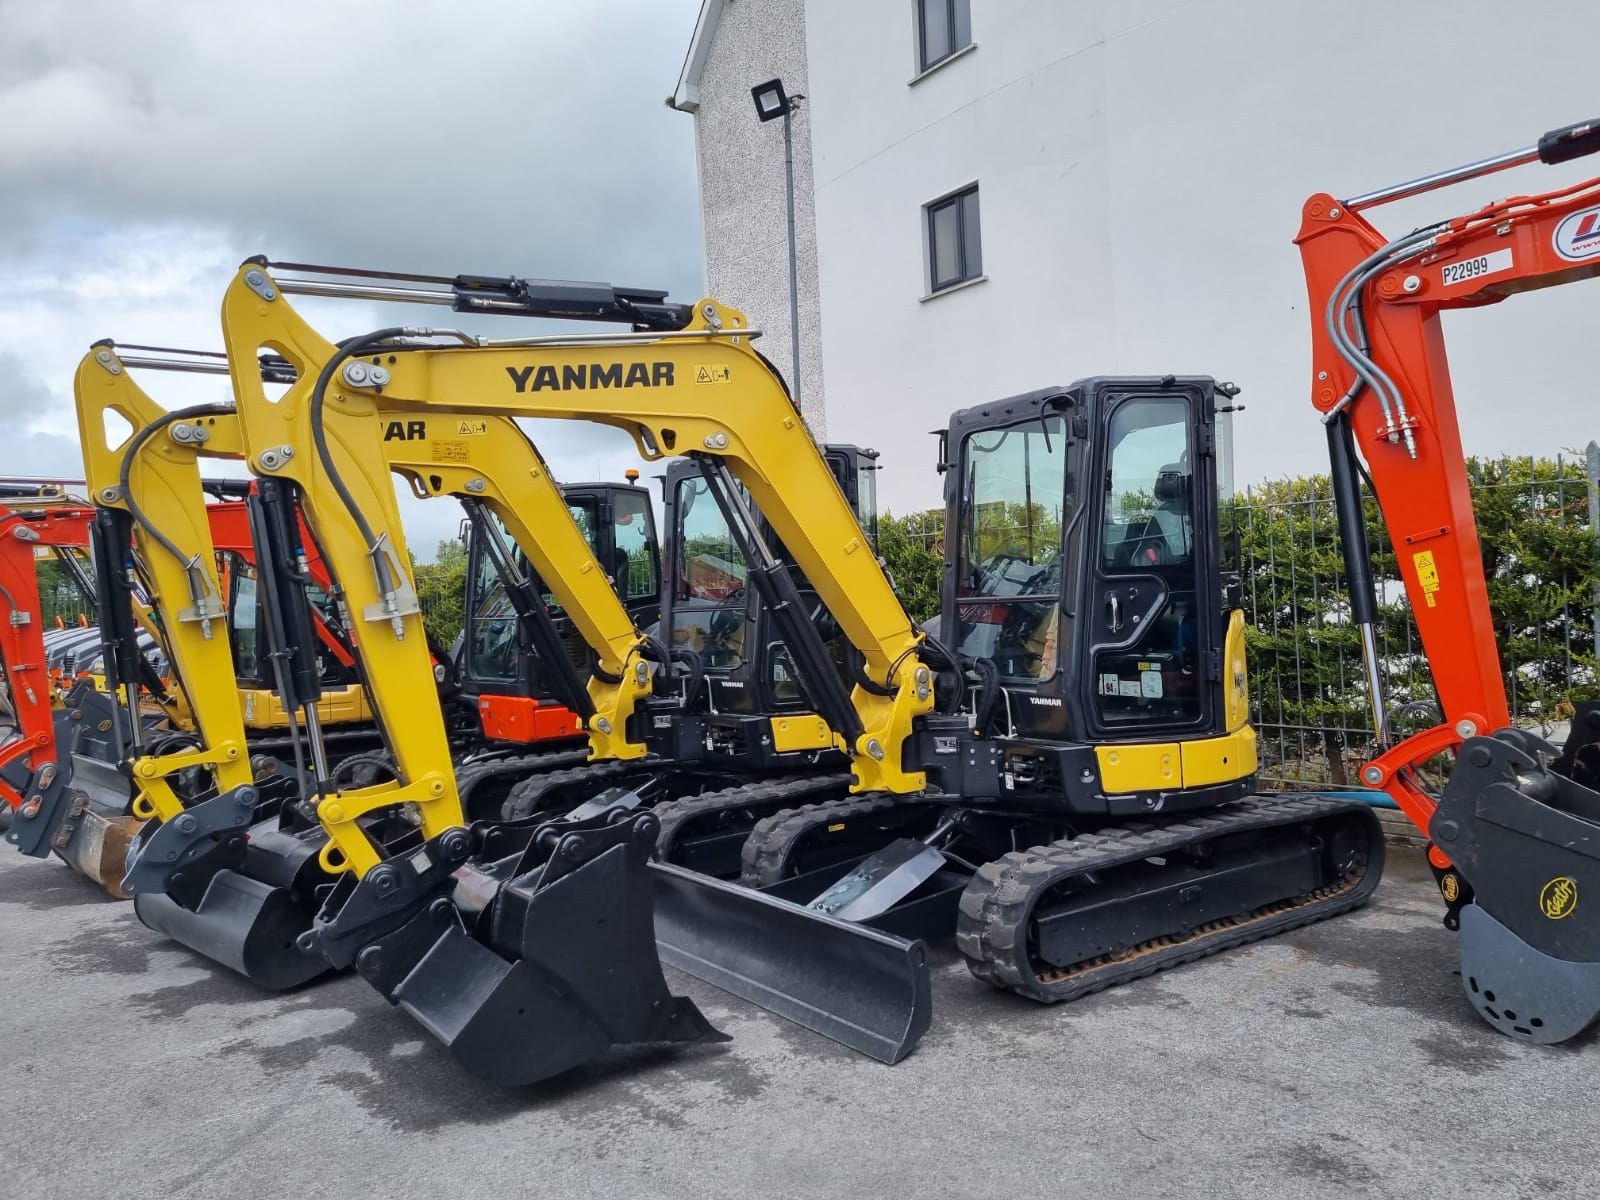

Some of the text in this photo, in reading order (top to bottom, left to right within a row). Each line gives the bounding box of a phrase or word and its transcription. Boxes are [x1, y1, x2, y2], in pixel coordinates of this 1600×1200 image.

[1443, 257, 1488, 284] P22999
[505, 361, 675, 393] YANMAR
[380, 421, 426, 441] AR
[1029, 696, 1062, 707] YANMAR
